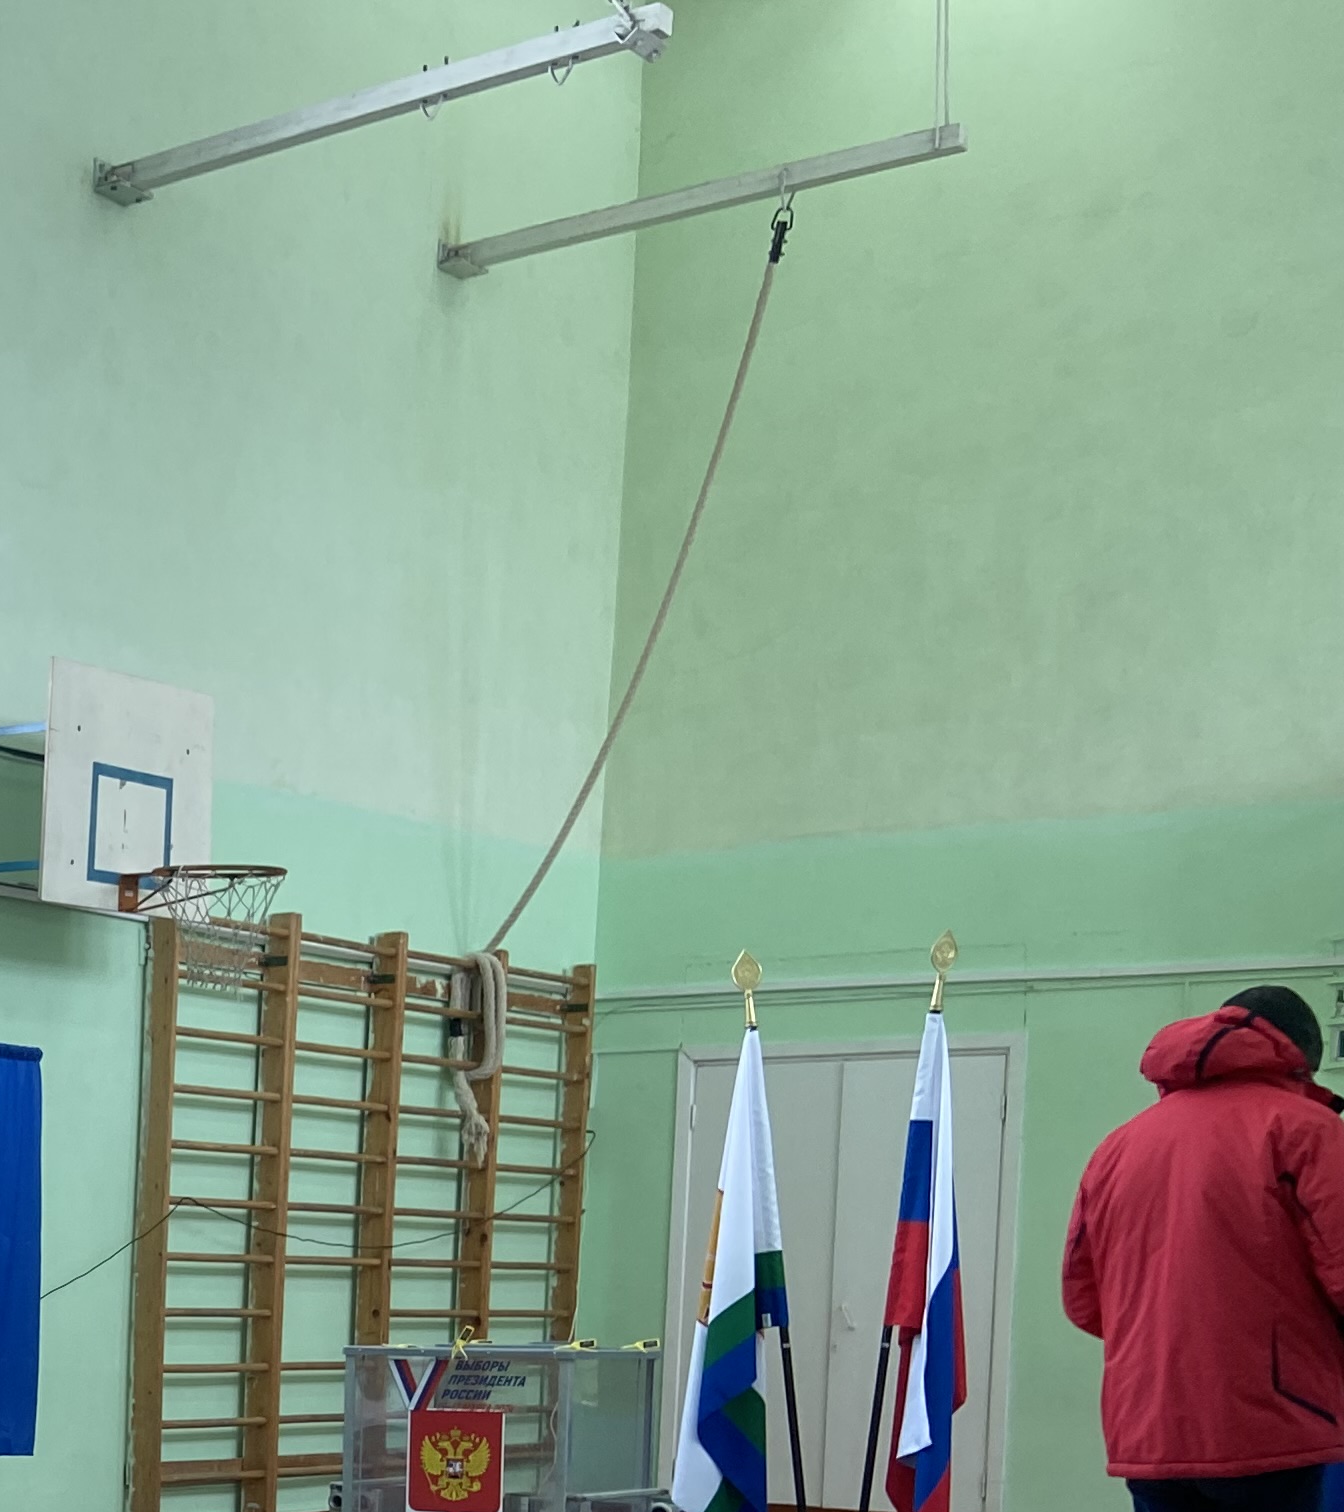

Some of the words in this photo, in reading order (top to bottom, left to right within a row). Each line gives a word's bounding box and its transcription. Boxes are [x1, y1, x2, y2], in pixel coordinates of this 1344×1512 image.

[454, 1359, 511, 1372] ВЫБОРЫ
[448, 1375, 527, 1388] ПРЕЗИДЕНТА
[441, 1389, 492, 1401] РОССИИ
